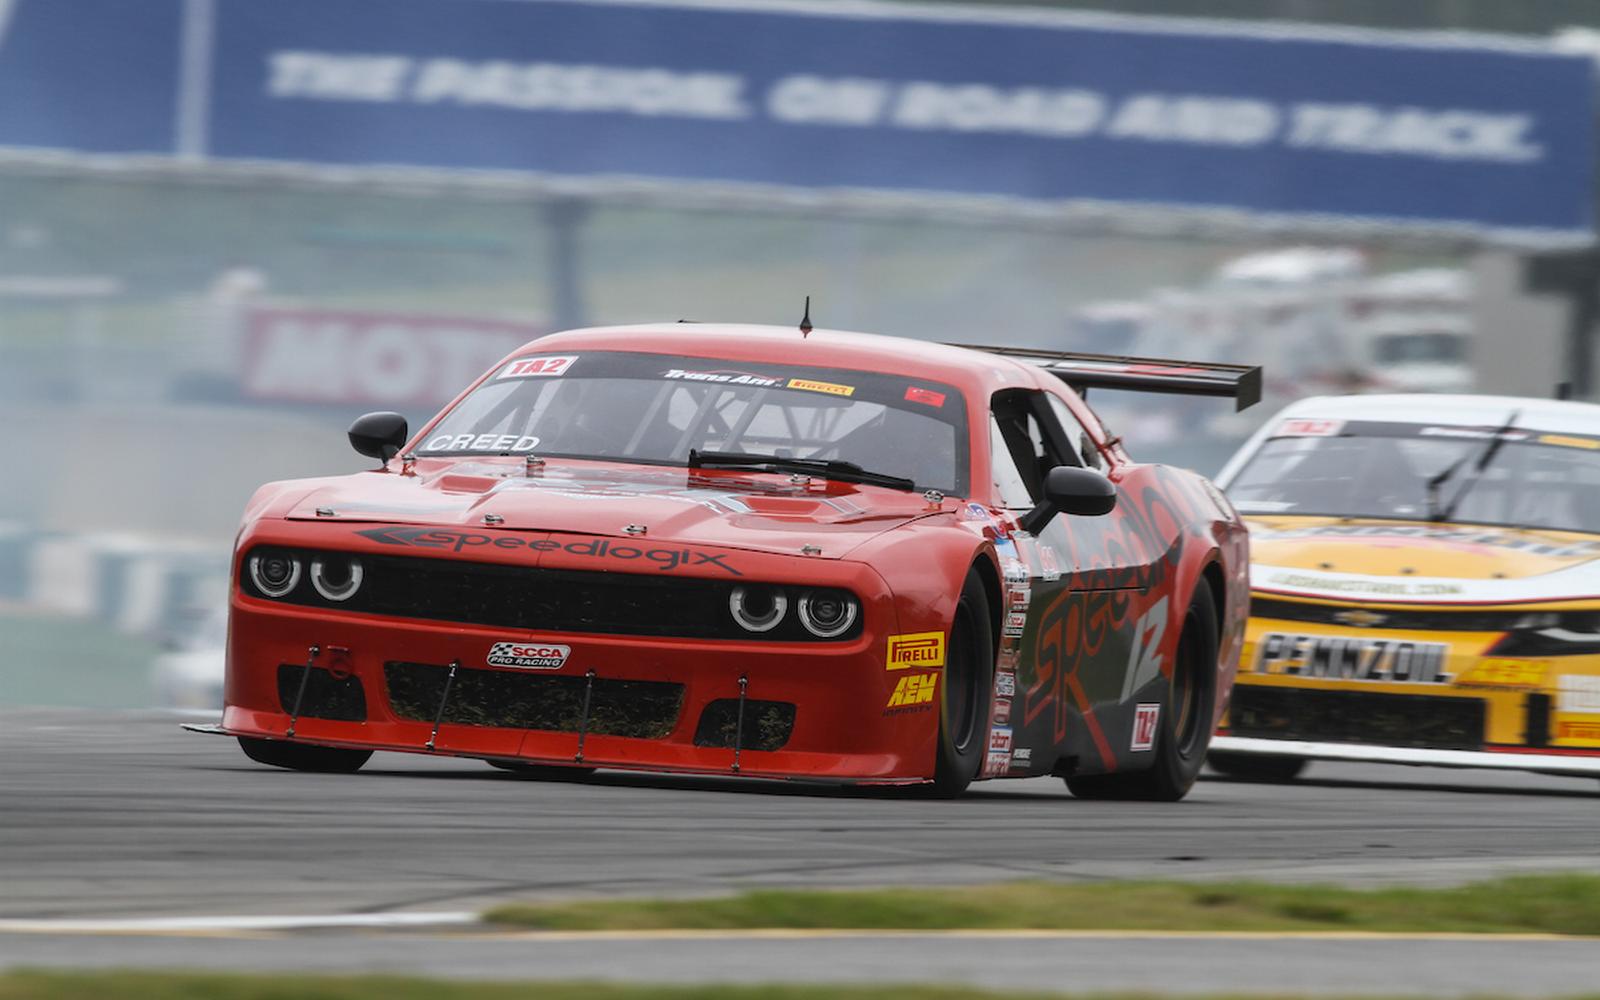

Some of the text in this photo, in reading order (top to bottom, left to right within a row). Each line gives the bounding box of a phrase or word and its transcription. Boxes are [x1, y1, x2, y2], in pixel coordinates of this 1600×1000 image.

[269, 51, 408, 100] THE
[768, 75, 888, 127] ON
[894, 81, 1102, 138] ROAD
[1105, 92, 1278, 147] AND
[510, 358, 566, 375] TA2
[664, 369, 777, 386] Trans Am
[793, 380, 849, 394] PIRELLI
[426, 434, 541, 451] CREED
[415, 528, 744, 577] speedlogix
[511, 646, 563, 658] SCCA
[891, 638, 939, 663] PIRELLI
[1119, 594, 1169, 705] 12
[1258, 633, 1454, 684] PENNZOIL
[490, 656, 561, 667] PRO RACING
[886, 672, 939, 708] AEM
